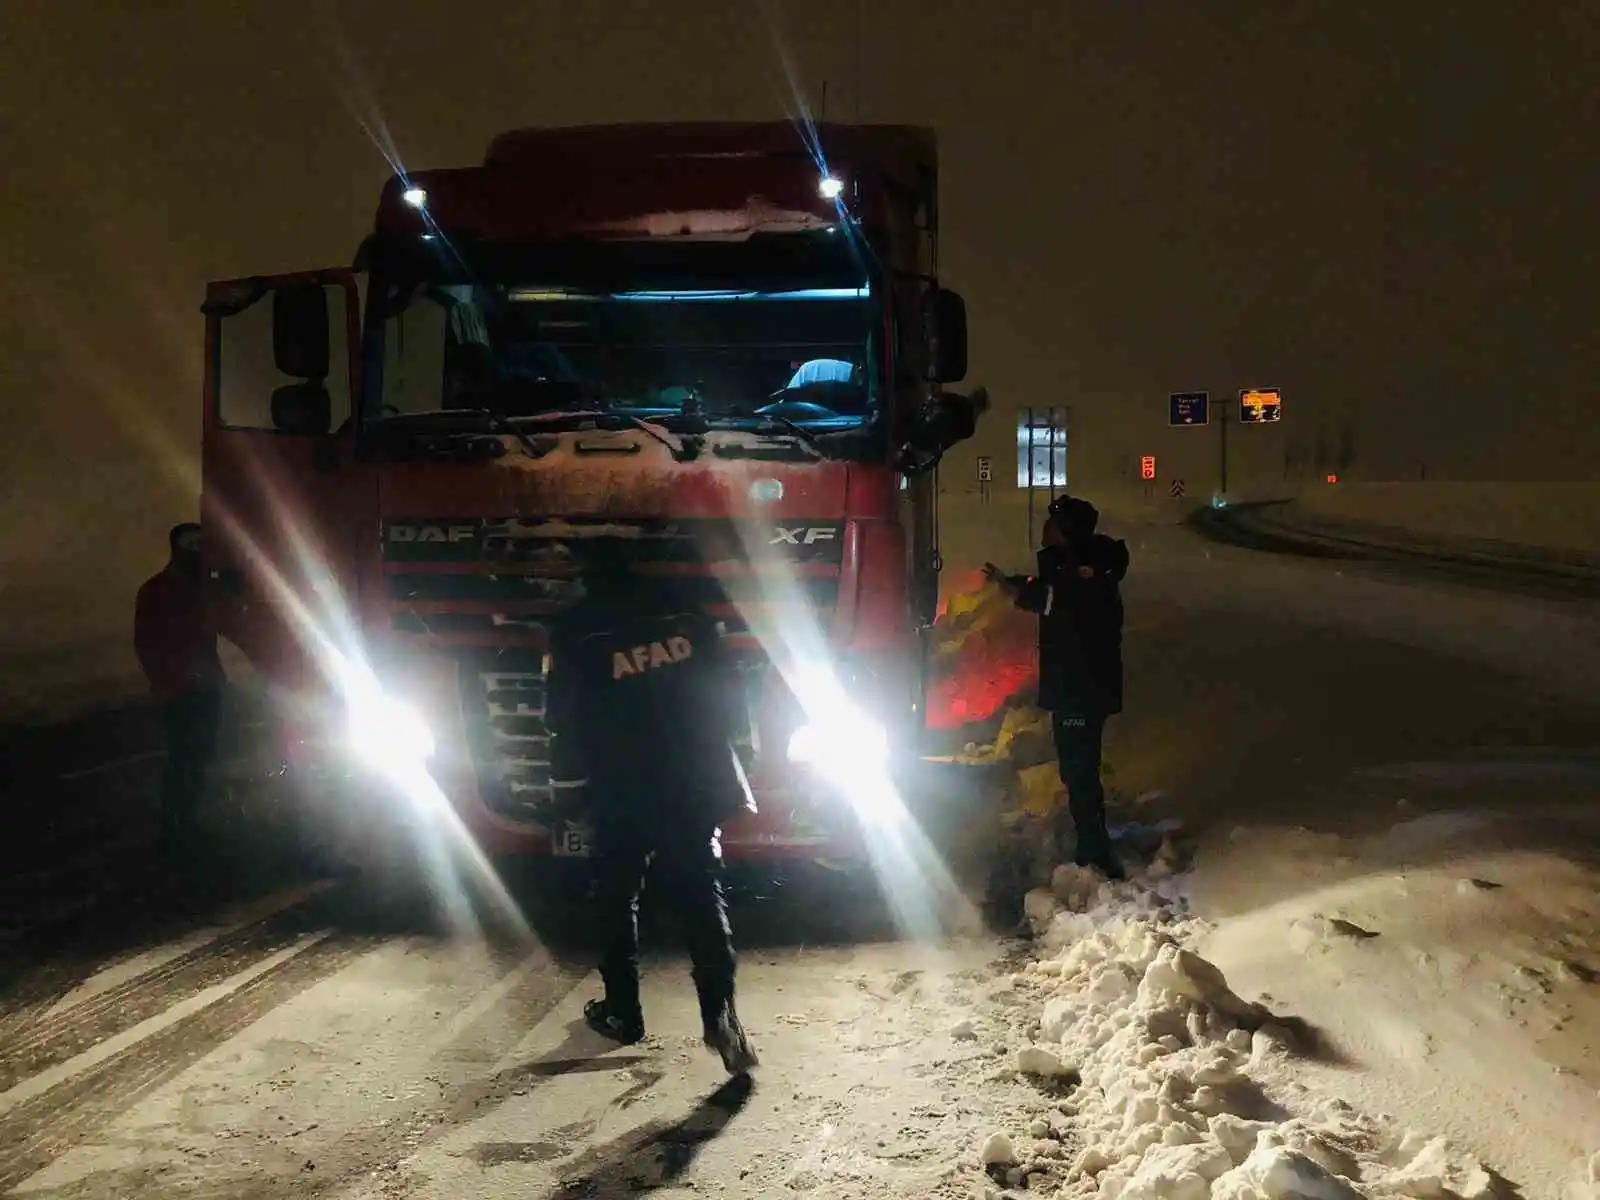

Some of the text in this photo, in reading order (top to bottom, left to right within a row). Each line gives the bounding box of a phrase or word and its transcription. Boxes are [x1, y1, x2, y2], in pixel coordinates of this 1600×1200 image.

[389, 525, 475, 543] DAF
[768, 527, 837, 545] XF
[611, 635, 693, 681] AFAD
